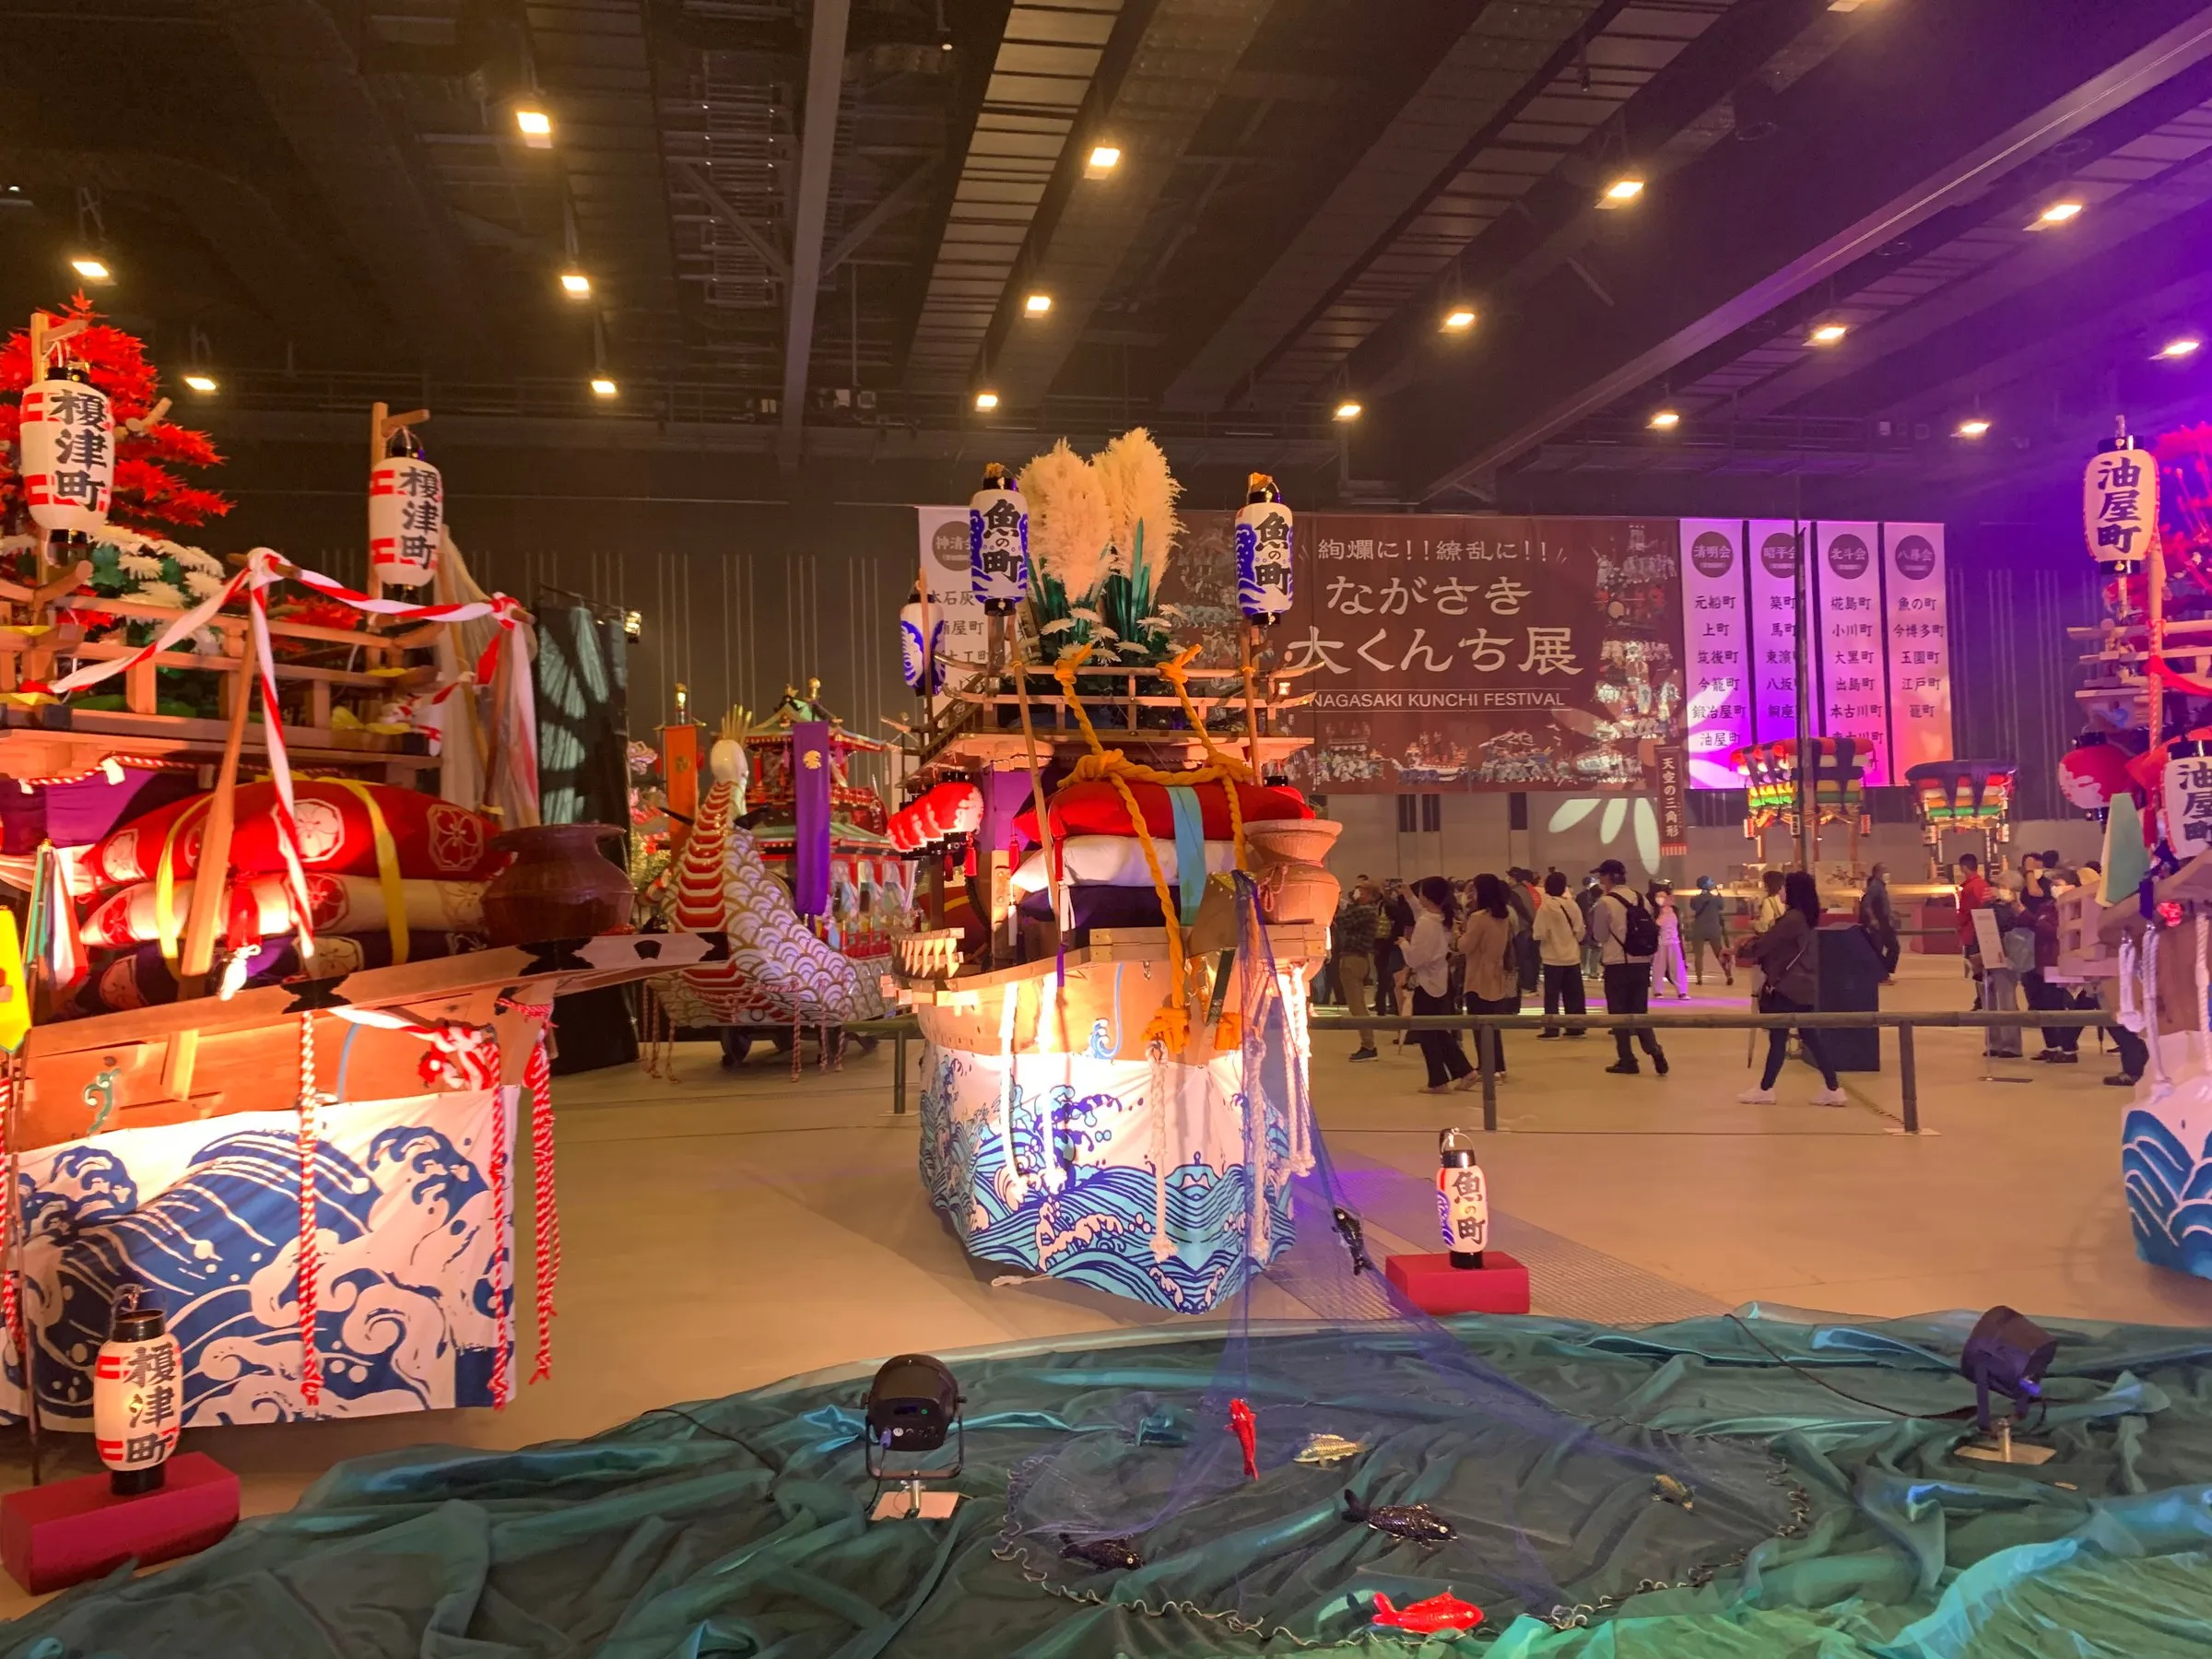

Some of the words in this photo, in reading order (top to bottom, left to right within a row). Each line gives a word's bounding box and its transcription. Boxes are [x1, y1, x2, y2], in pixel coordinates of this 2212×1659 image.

[49, 388, 109, 512] 榎津町
[2097, 456, 2143, 554] 油屋町
[397, 465, 440, 570] 榎津町
[982, 499, 1024, 582] 魚の町
[1254, 512, 1291, 595] 魚の町
[1325, 575, 1532, 616] ながさき
[1694, 595, 1735, 609] 元船町
[1899, 597, 1936, 611] 魚の町
[1702, 623, 1730, 637] 上町
[1831, 623, 1873, 638] 小川町
[1893, 623, 1944, 638] 今博多町
[1288, 625, 1584, 676] 大くんち展
[1835, 651, 1875, 664] 大黒町
[1900, 651, 1940, 665] 玉園町
[1766, 677, 1796, 691] 八坂
[1836, 677, 1875, 691] 出島町
[1901, 677, 1941, 691] 江戸町
[1310, 693, 1402, 708] NAGASAKI
[1407, 692, 1478, 708] KUNCHI
[1484, 692, 1566, 707] FESTIVAL
[1768, 703, 1794, 719] 銅座
[1830, 704, 1881, 718] 本古川町
[1700, 732, 1741, 747] 油屋町
[1662, 757, 1679, 838] 天空の三角形
[1452, 1171, 1486, 1244] 魚の町
[124, 1341, 177, 1463] 榎津町
